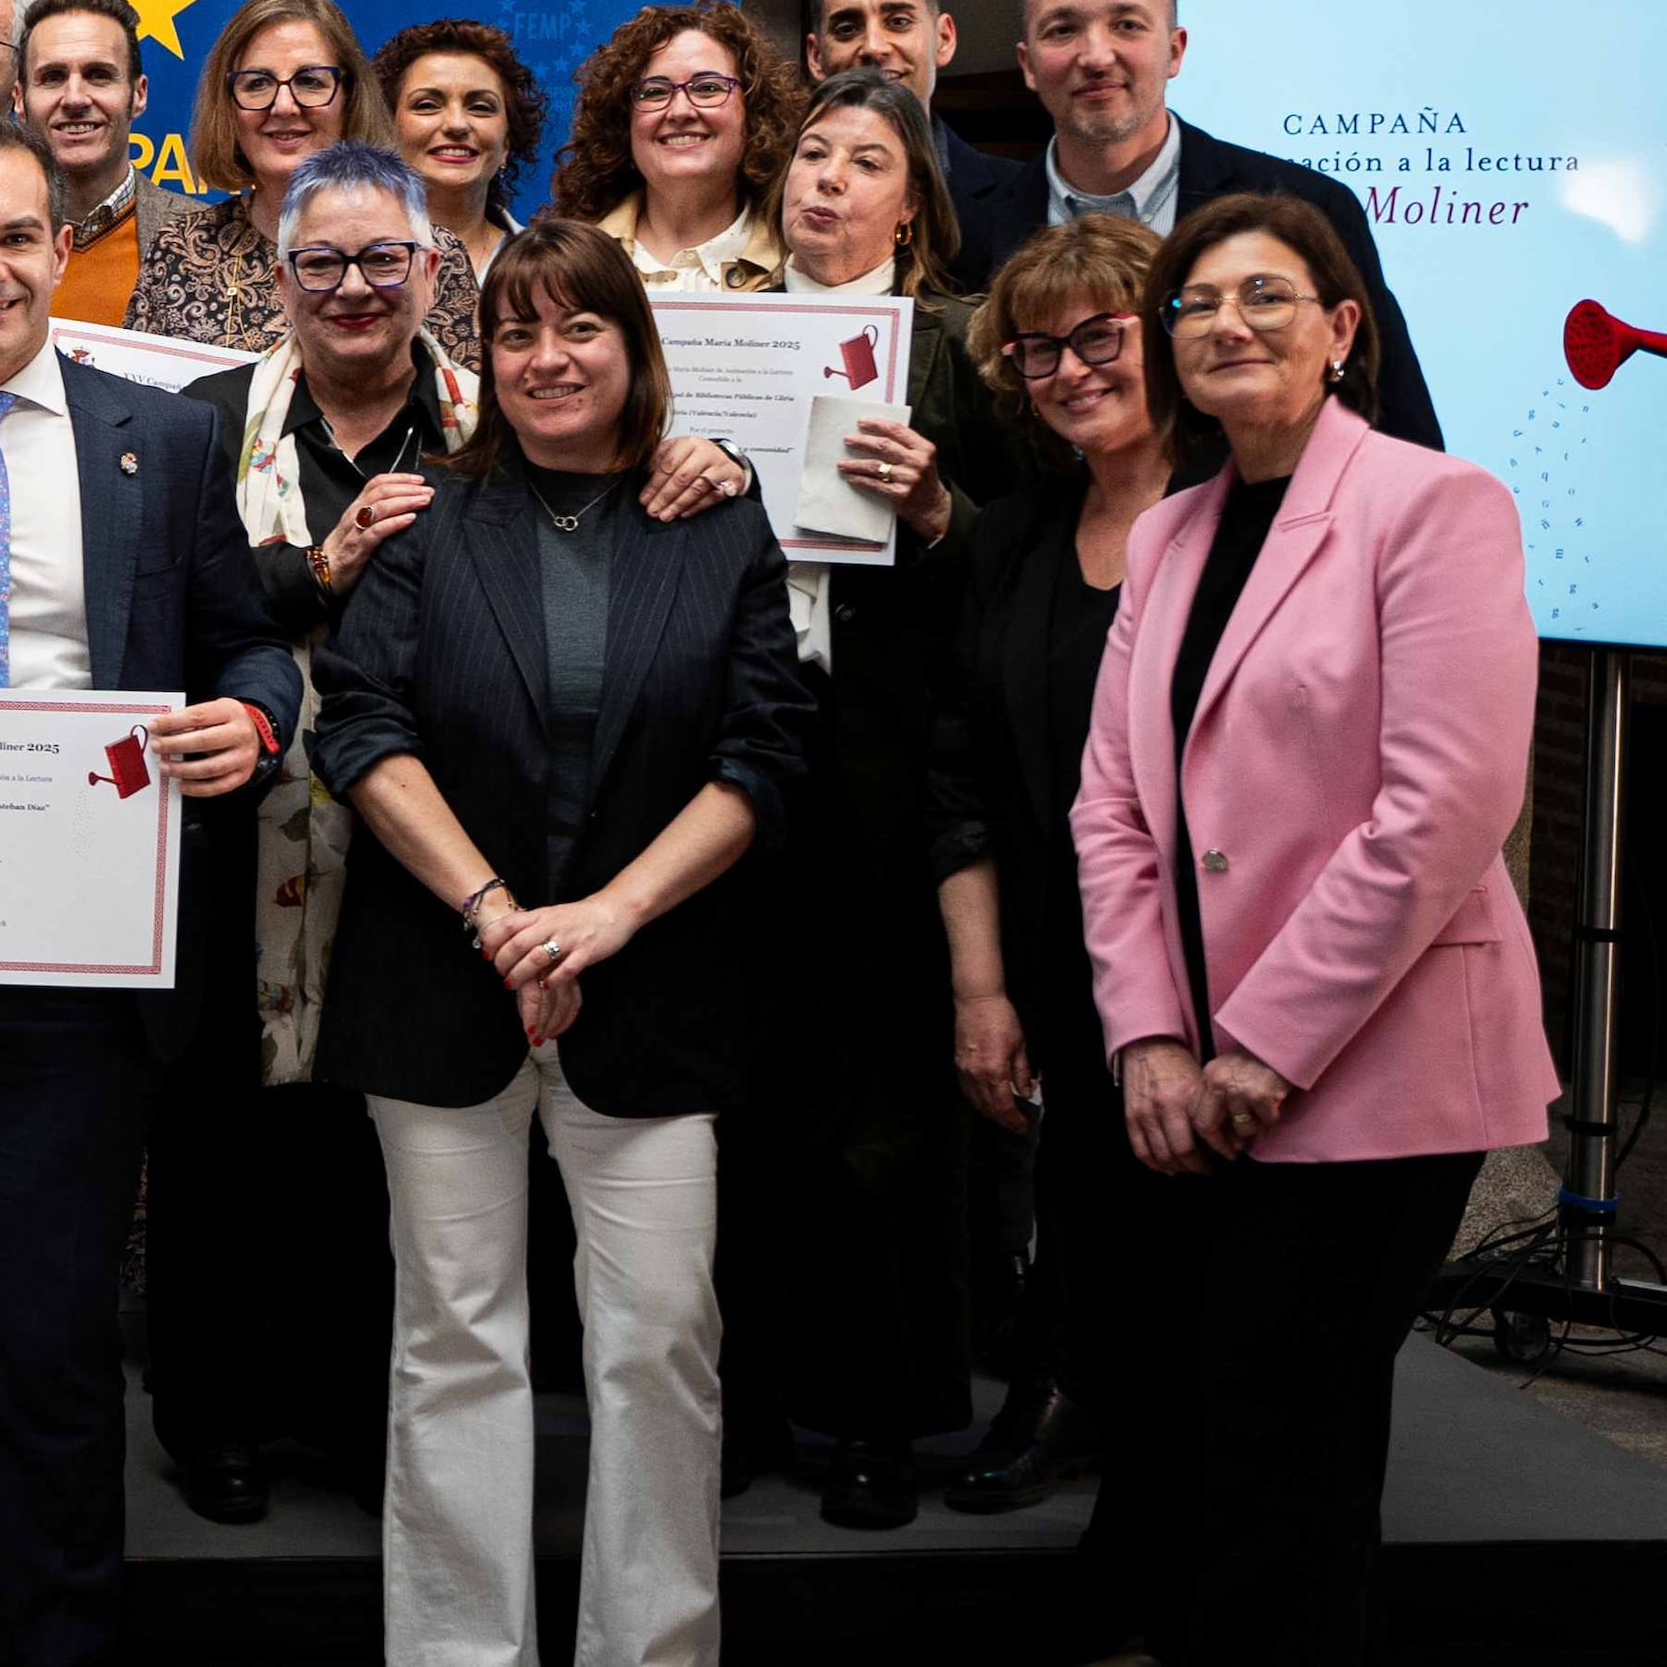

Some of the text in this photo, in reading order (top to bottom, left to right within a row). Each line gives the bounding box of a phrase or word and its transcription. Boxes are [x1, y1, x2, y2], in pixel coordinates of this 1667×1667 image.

[1283, 107, 1467, 135] CAMPAÑA
[1291, 148, 1579, 172] ación a la lectura
[1366, 186, 1529, 224] Moliner
[662, 337, 800, 350] Campaña María Moliner 2025
[26, 744, 59, 754] 2025
